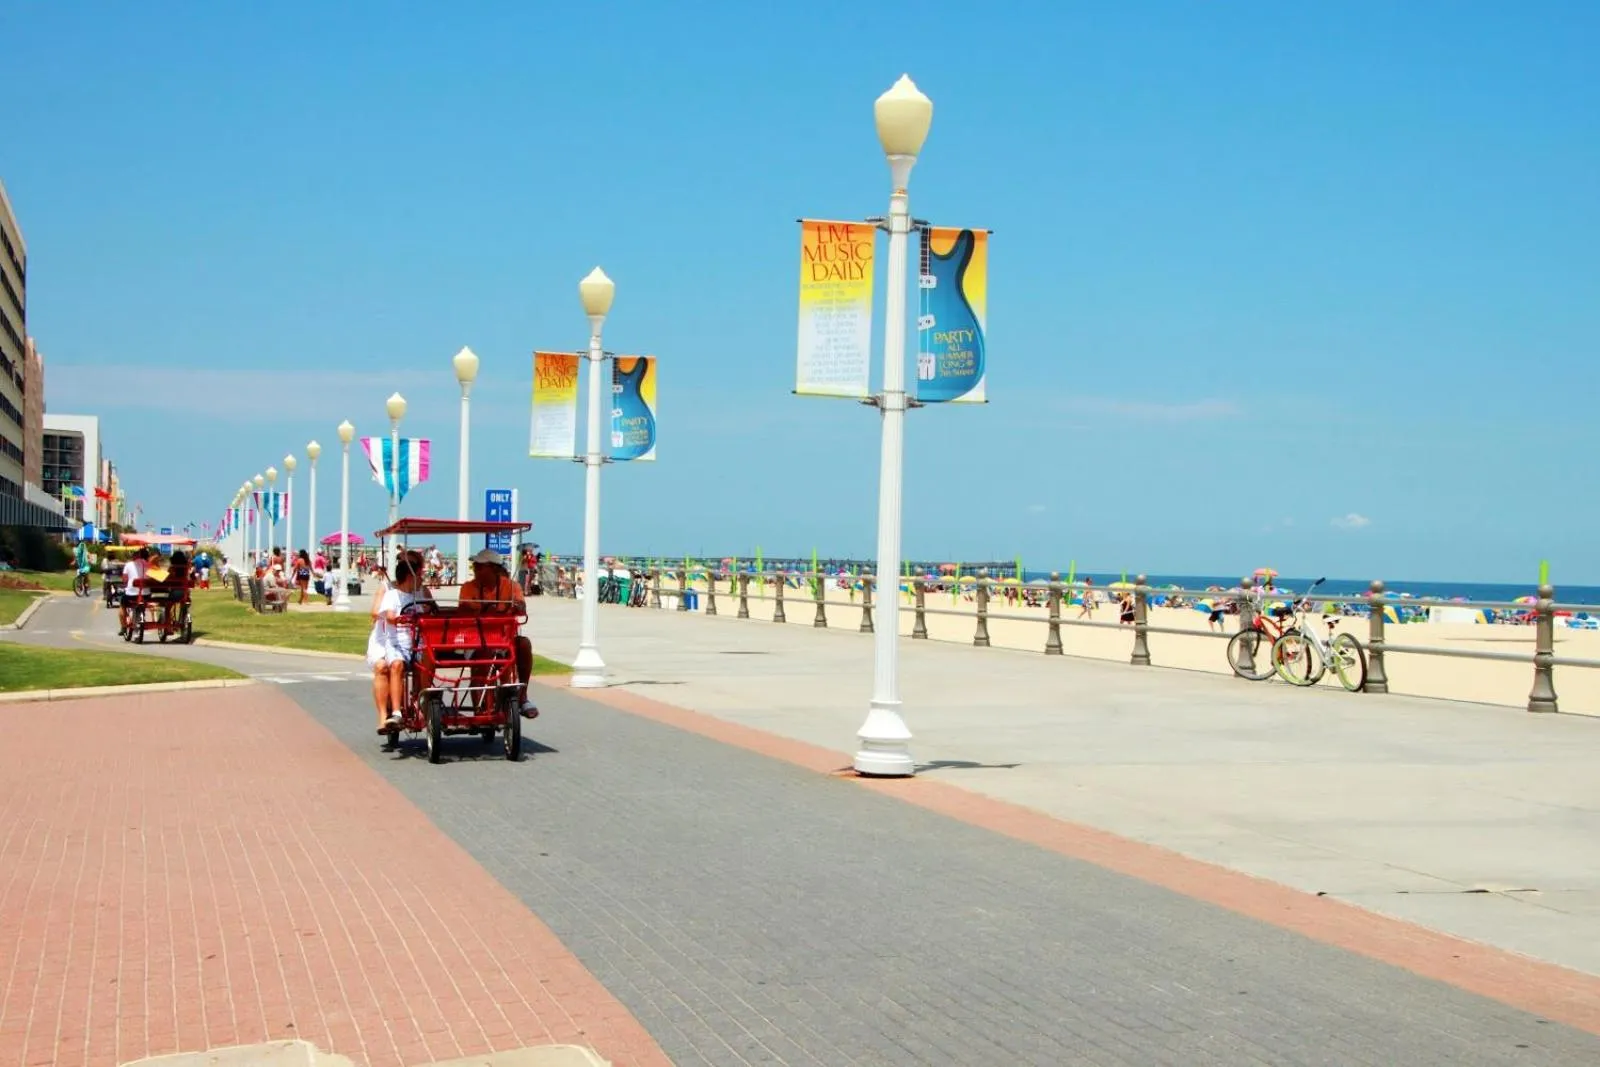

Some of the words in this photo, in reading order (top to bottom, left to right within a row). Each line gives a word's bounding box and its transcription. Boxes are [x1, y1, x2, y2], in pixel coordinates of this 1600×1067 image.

[817, 224, 857, 244] LIVE
[804, 242, 873, 262] MUSIC
[812, 260, 867, 281] DAILY
[934, 330, 973, 344] PARTY
[543, 355, 568, 366] LIVE
[536, 365, 577, 377] MUSIC
[540, 376, 574, 389] DAILY
[490, 493, 509, 502] ONLY
